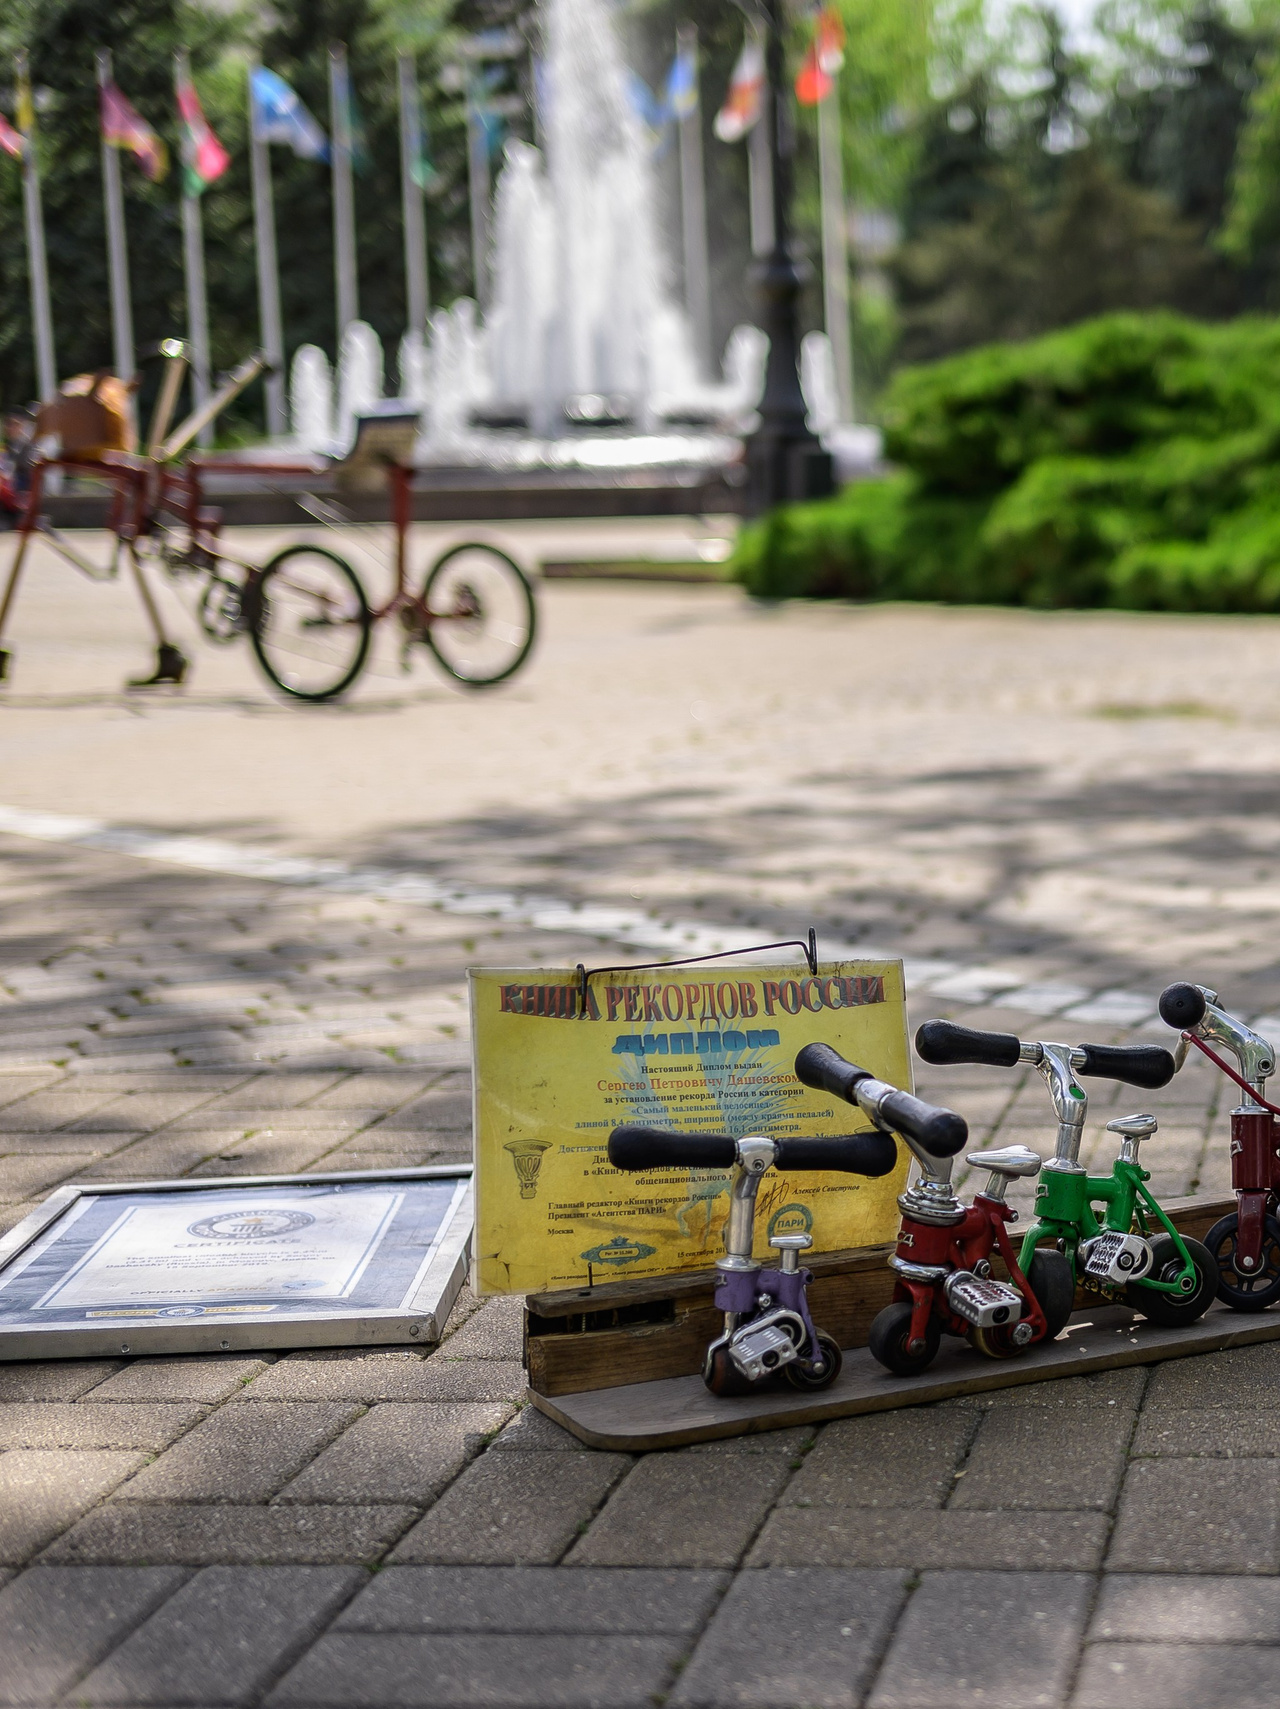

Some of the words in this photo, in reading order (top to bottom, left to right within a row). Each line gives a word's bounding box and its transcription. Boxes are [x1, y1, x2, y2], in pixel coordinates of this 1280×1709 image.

[498, 982, 602, 1021] КНИГА
[604, 981, 758, 1030] РЕКОРДОВ
[760, 976, 887, 1016] РОССИИ
[611, 1029, 780, 1057] ДИПЛОМ
[641, 1063, 694, 1074] Настоящий
[695, 1062, 732, 1073] Диплом
[734, 1062, 763, 1071] выдан
[597, 1079, 647, 1096] Сергею
[650, 1078, 723, 1092] Петровичу
[727, 1074, 801, 1088] Дашевском
[604, 1096, 613, 1104] за
[615, 1093, 677, 1106] установление
[679, 1092, 716, 1103] рекорда
[718, 1090, 749, 1099] России
[759, 1088, 804, 1099] категории
[631, 1105, 669, 1115] «Самый
[672, 1103, 722, 1113] маленький
[574, 1119, 609, 1129] длиной
[684, 1114, 725, 1125] шириной
[761, 1111, 794, 1122] краями
[796, 1109, 834, 1119] педалей)
[748, 1123, 802, 1134] сантиметра.
[635, 1174, 729, 1186] общенационального
[791, 1186, 821, 1196] Алексей
[822, 1184, 861, 1194] Свистунов
[548, 1200, 585, 1210] Главный
[586, 1199, 623, 1210] редактор
[624, 1197, 653, 1206] «Книги
[655, 1195, 690, 1205] рекордов
[548, 1211, 590, 1221] Президент
[591, 1208, 636, 1218] «Агентства
[638, 1206, 667, 1216] ПАРИ»
[777, 1218, 804, 1229] ПАРИ
[547, 1227, 574, 1237] Москва
[172, 1239, 301, 1249] CERTIFICATE
[685, 1248, 714, 1257] сентября
[715, 1246, 727, 1255] 201
